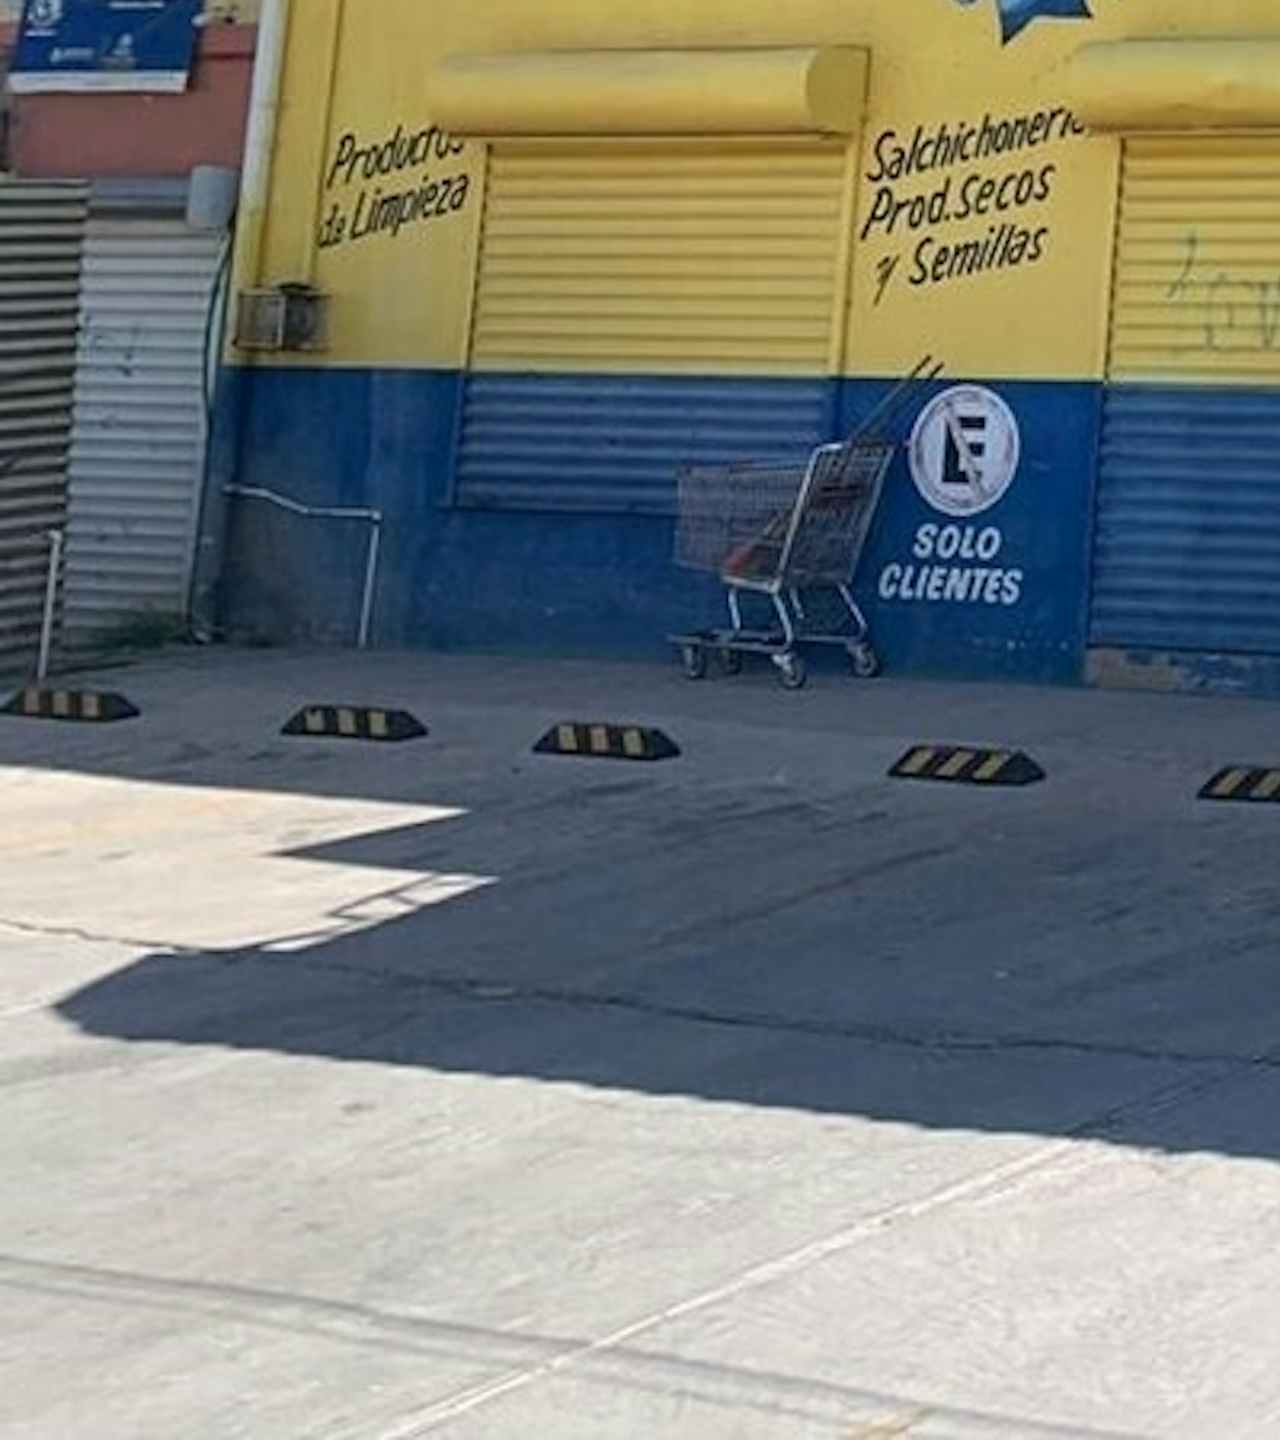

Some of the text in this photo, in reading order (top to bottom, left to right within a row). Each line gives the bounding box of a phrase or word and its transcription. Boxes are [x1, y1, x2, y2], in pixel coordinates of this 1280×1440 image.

[349, 172, 470, 238] Limpieza
[908, 222, 1048, 286] Semillas
[912, 523, 1001, 560] SOLO
[877, 561, 1024, 606] CLIENTES
